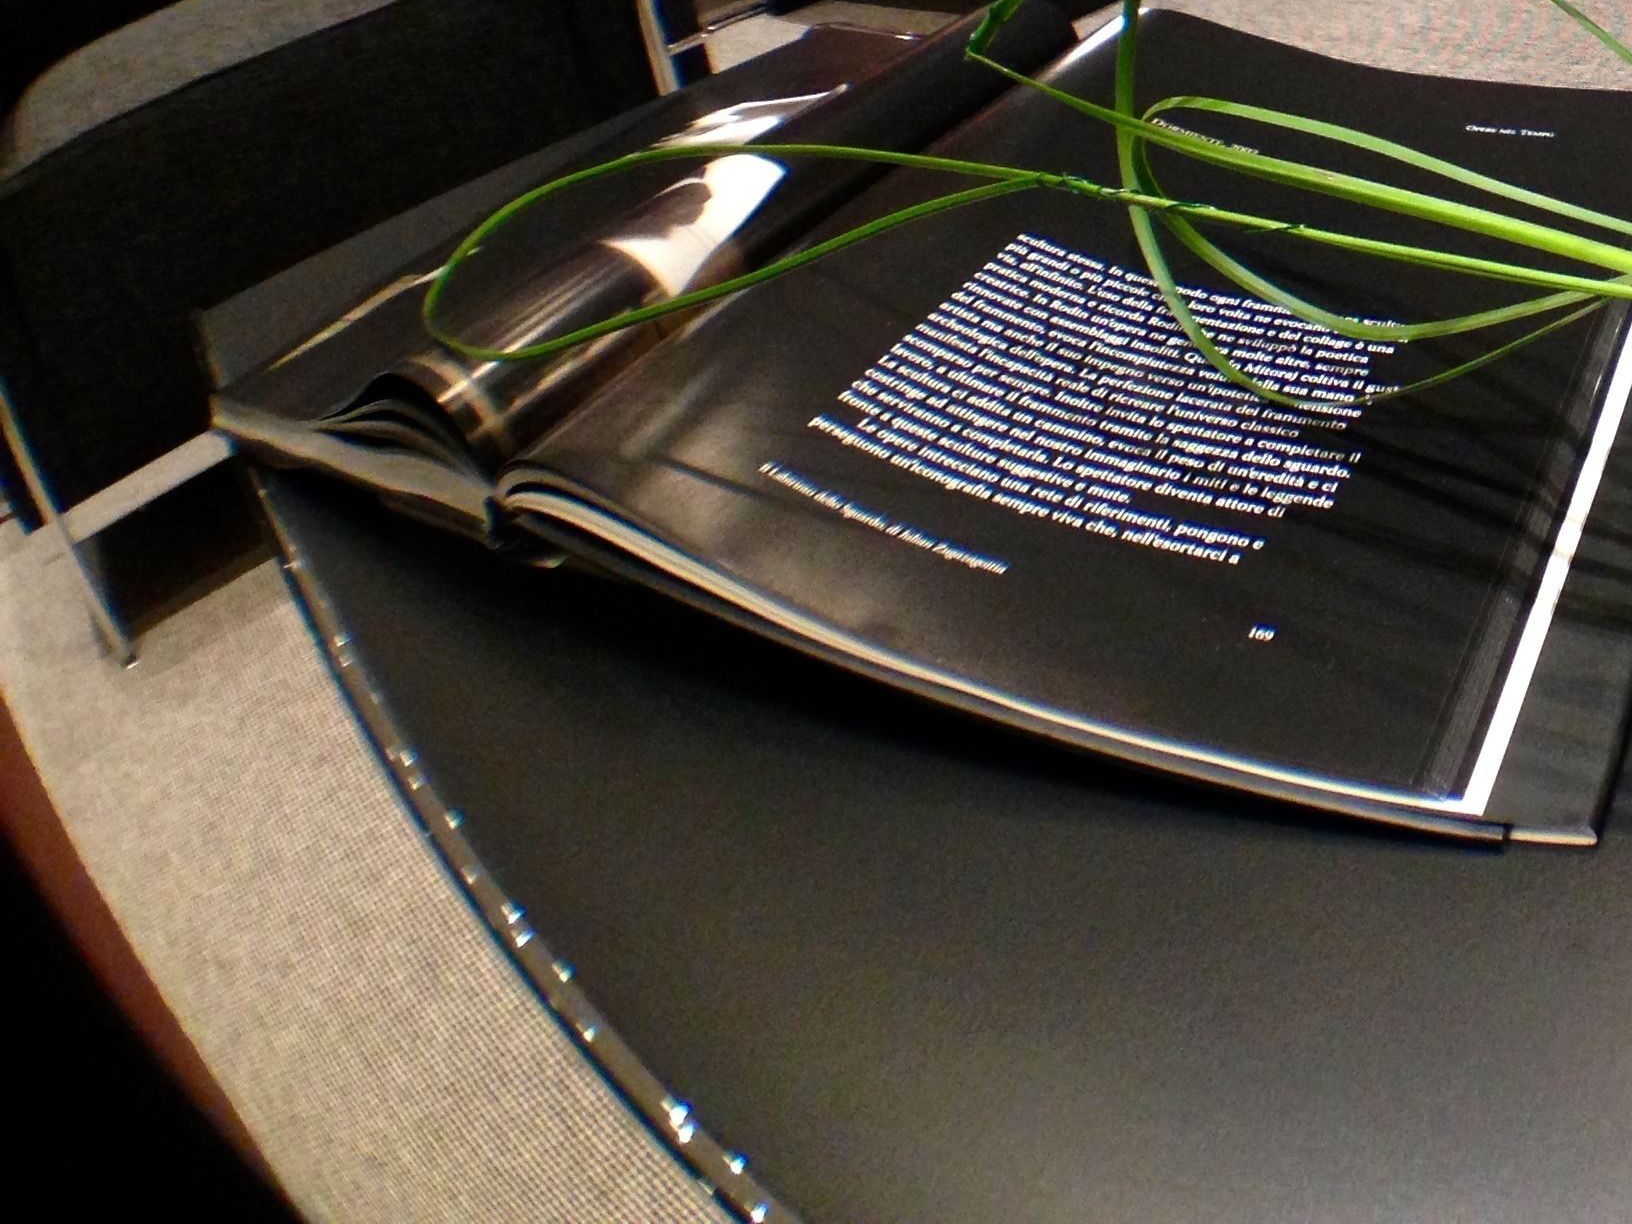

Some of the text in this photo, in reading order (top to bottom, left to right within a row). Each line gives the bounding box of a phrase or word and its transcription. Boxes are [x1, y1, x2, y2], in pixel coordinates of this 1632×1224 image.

[974, 267, 1032, 298] creatrice.
[1032, 293, 1048, 305] In
[1049, 300, 1089, 319] Rodin
[1090, 315, 1147, 336] un'opera
[1149, 332, 1167, 341] ne
[1231, 350, 1273, 362] molte
[1315, 363, 1369, 376] sempre
[983, 262, 1028, 283] pratica
[1029, 280, 1086, 304] moderna
[1097, 304, 1145, 322] ricorda
[1217, 334, 1235, 342] ne
[1300, 345, 1313, 355] la
[1315, 347, 1369, 364] poetica
[997, 248, 1017, 266] via,
[1122, 297, 1154, 311] della
[1278, 330, 1302, 341] del
[1303, 335, 1352, 349] collage
[1354, 341, 1364, 350] è
[1367, 344, 1394, 354] una
[1004, 243, 1272, 323] più grandi più piccole loro volta ne
[1017, 234, 1240, 306] scultura stessa. In ogni
[927, 313, 1347, 429] archeologica dell'opera. La perfezione lacerata del frammento
[939, 302, 1184, 387] artista ma anche il suo impegno verso
[951, 291, 976, 304] del
[972, 299, 1045, 334] frammento,
[1048, 330, 1087, 348] evoca
[1088, 341, 1195, 375] l'incompiutezza
[1282, 385, 1308, 396] sua
[1311, 390, 1355, 403] mano
[962, 282, 1023, 310] rinnovate
[1023, 306, 1049, 320] con
[1243, 363, 1299, 381] Mitoraj
[1300, 374, 1349, 388] coltiva
[1352, 381, 1364, 390] il
[837, 390, 1130, 504] fronte queste sculture suggestive e mute.
[864, 368, 927, 400] costringe
[926, 396, 949, 408] ad
[946, 404, 1009, 432] attingere
[1009, 427, 1036, 441] nel
[1034, 436, 1083, 456] nostro
[1084, 449, 1181, 480] immaginario
[1193, 477, 1227, 489] miti
[1243, 483, 1258, 495] le
[1260, 486, 1334, 509] leggende
[878, 355, 1338, 493] La scultura ci addita un cammino, evoca il peso di un'eredità e ci
[890, 343, 1350, 478] lavoro, ultimare il frammento tramite la saggezza dello sguardo.
[899, 334, 1361, 463] scomparso per sempre. Inoltre invita lo spettatore a completare il
[978, 348, 1054, 382] l'incapacità
[1055, 378, 1090, 393] reale
[1091, 384, 1109, 398] di
[1108, 393, 1165, 412] ricreare
[1166, 404, 1238, 427] l'universo
[1240, 421, 1299, 437] classico
[851, 380, 1285, 518] che serviranno completarla. Lo spettatore diventa attore di
[857, 418, 1264, 550] Le opere intrecciano una rete di riferimenti, pongono e
[992, 493, 1050, 517] sempre
[1052, 511, 1083, 528] viva
[1085, 520, 1117, 538] che,
[1121, 530, 1227, 562] nell'esortarci
[1228, 554, 1240, 564] a
[1248, 626, 1275, 642] 169
